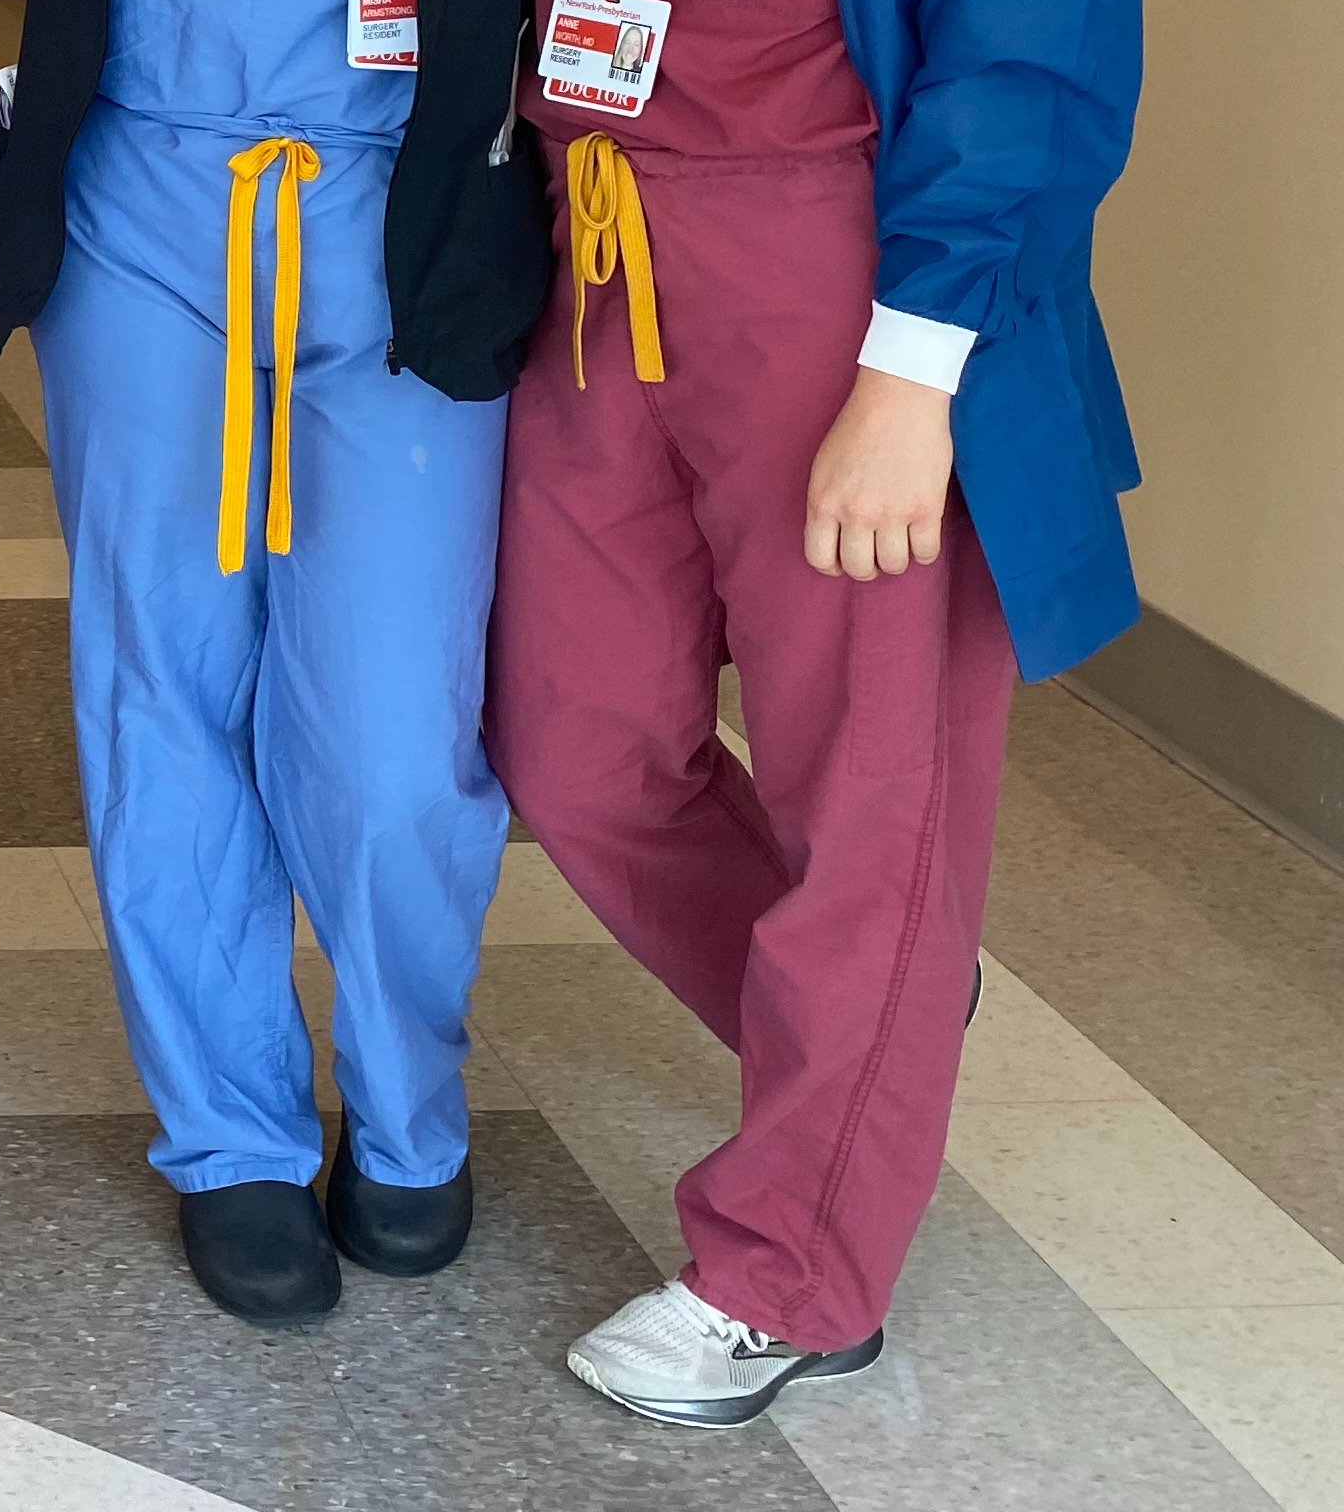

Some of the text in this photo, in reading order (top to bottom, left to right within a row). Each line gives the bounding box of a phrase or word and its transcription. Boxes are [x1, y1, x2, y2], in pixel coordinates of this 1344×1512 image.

[363, 21, 400, 33] SURGERY
[557, 17, 580, 31] ANNE
[363, 29, 402, 41] RESIDENT
[582, 36, 595, 48] MD
[552, 44, 581, 57] SURGERY
[550, 53, 581, 66] RESIDENT
[557, 79, 630, 107] DOCTOR
